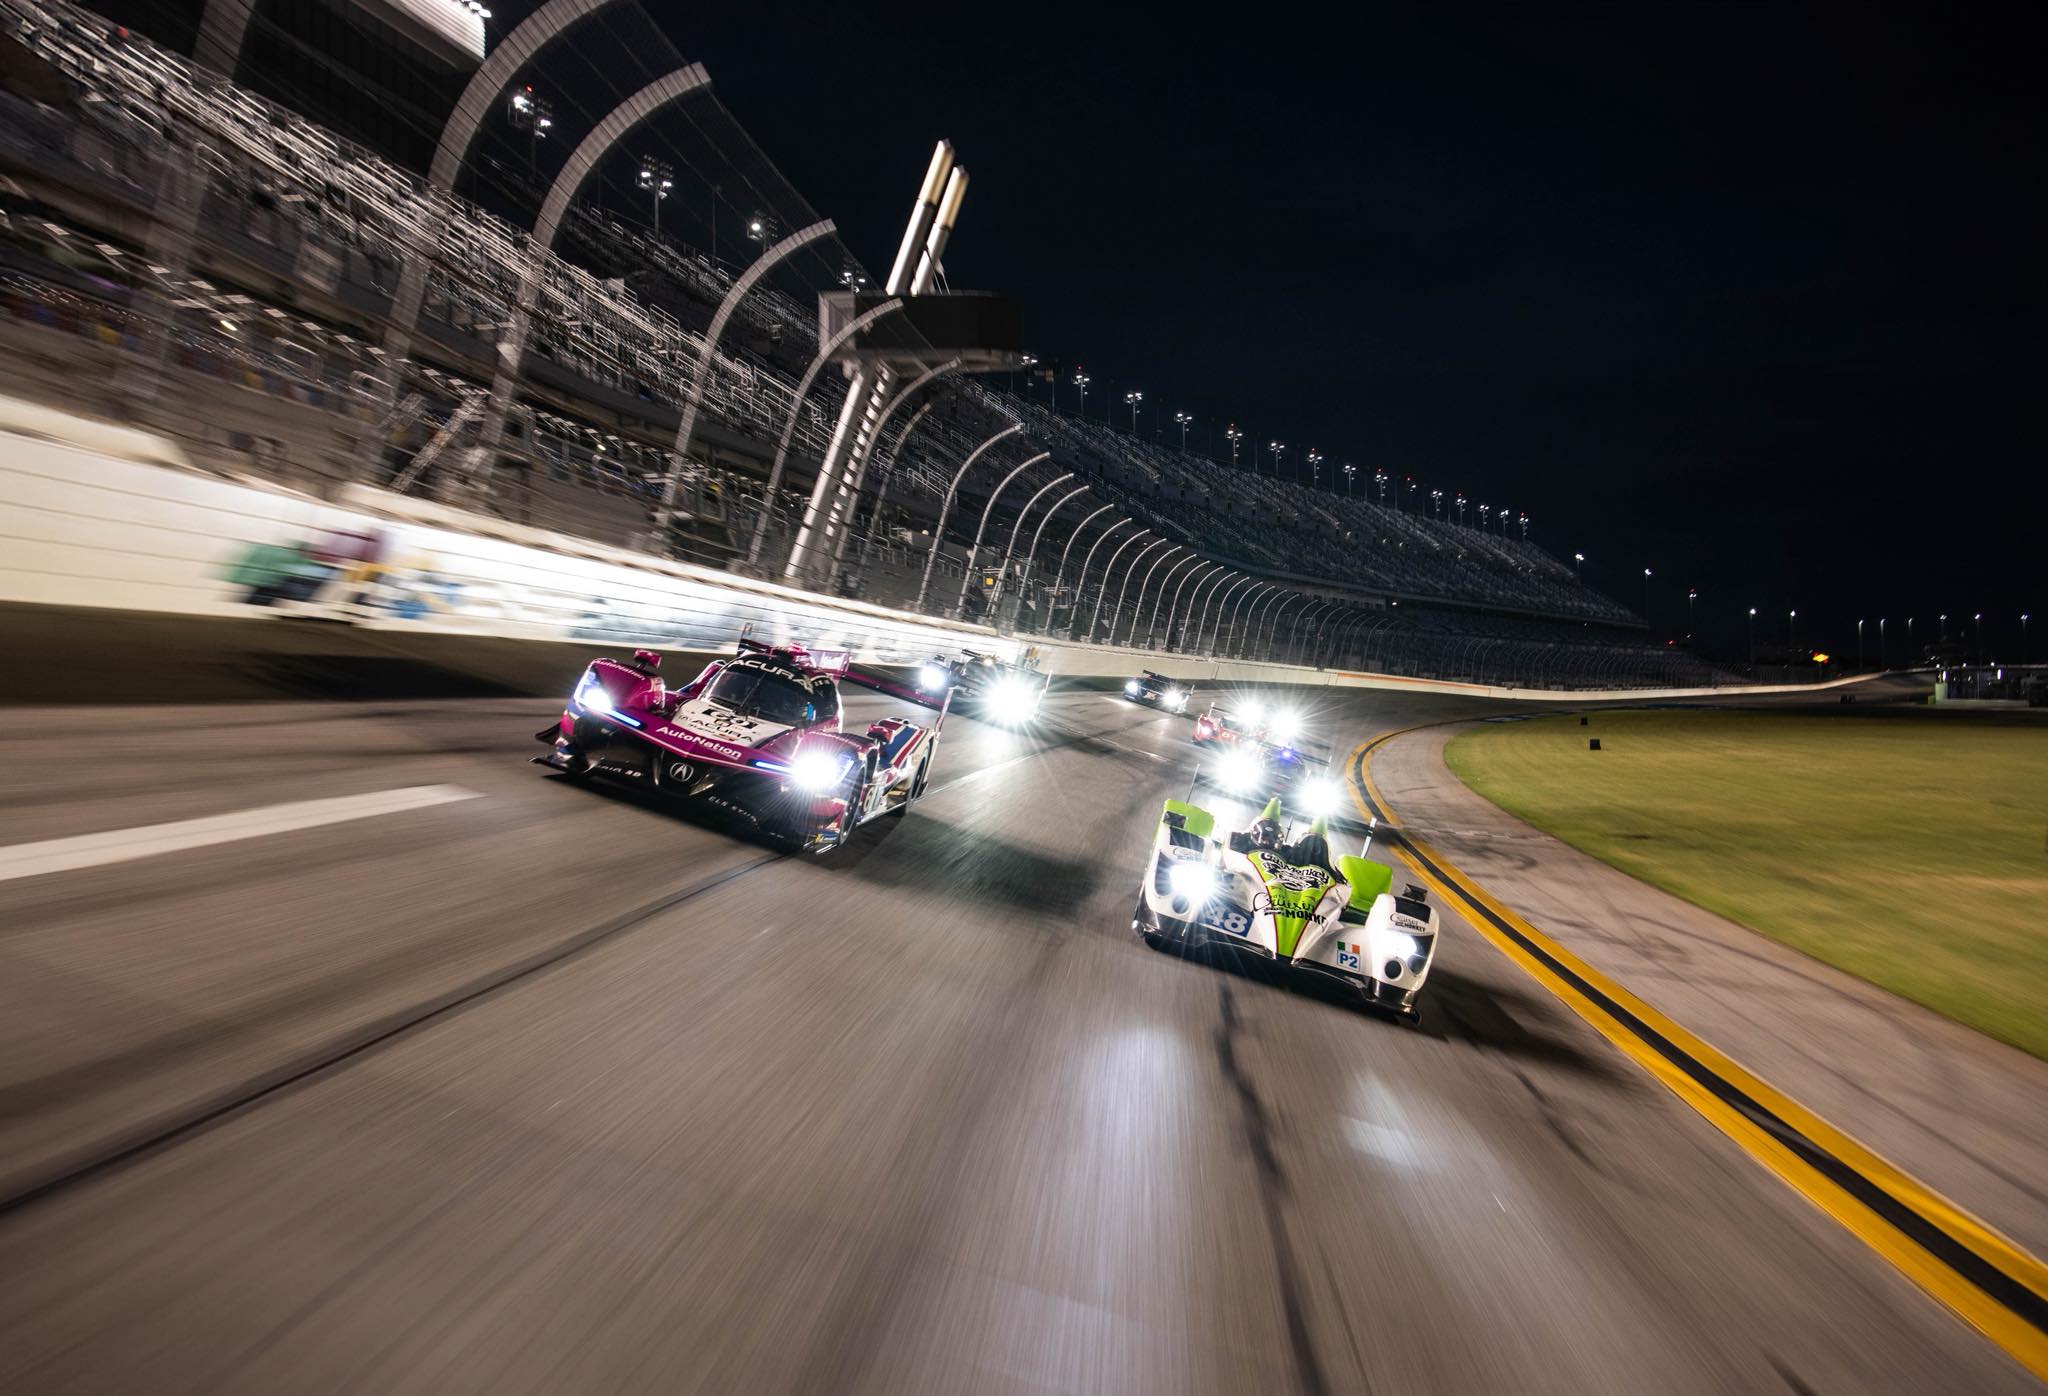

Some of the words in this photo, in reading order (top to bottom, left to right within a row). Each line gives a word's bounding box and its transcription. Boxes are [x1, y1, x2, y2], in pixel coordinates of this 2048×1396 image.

[733, 659, 814, 695] ACURA
[656, 726, 742, 761] AutoNation
[691, 719, 753, 742] ACURA
[1205, 903, 1248, 934] 48
[1339, 952, 1358, 968] P2
